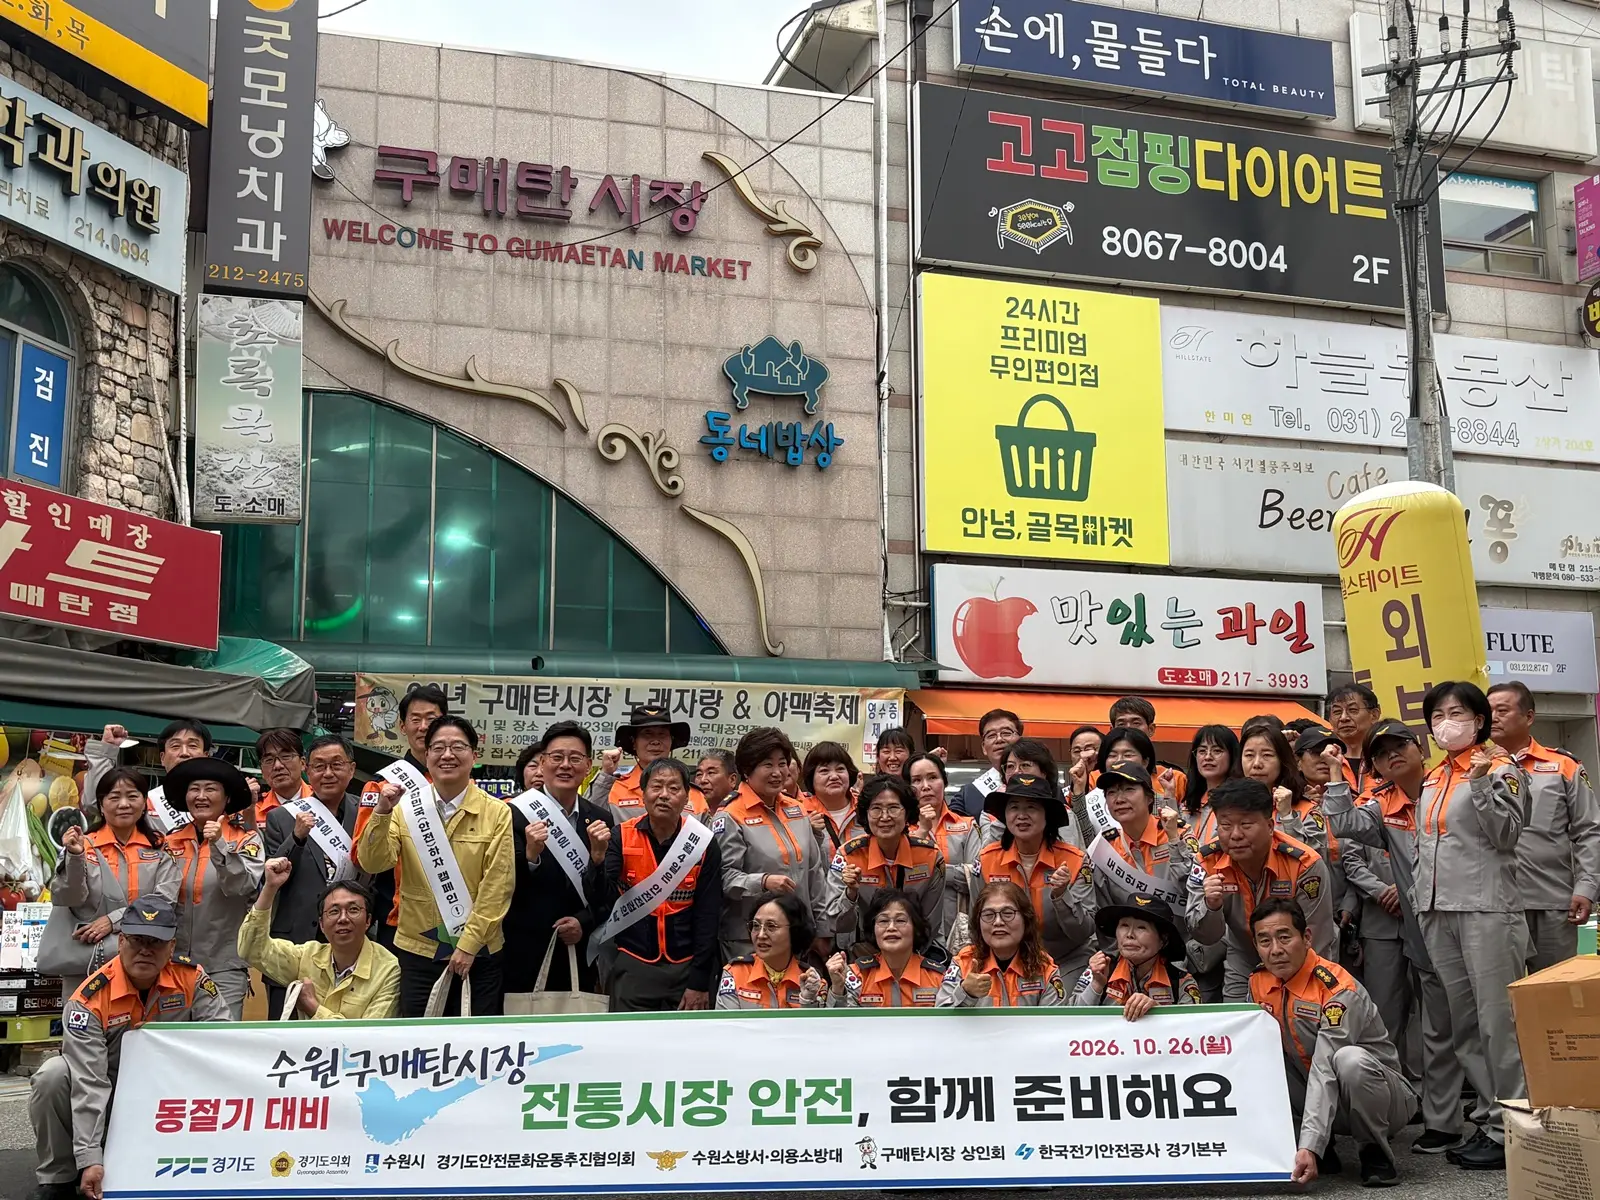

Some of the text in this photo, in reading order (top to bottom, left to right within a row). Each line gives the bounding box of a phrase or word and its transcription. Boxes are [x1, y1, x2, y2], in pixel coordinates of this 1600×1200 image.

[1222, 77, 1325, 100] TOTAL BEAUTY
[233, 15, 291, 262] 굿모닝치과
[373, 144, 708, 234] 구매탄시장
[73, 216, 150, 266] 214.0894
[322, 217, 752, 281] WELCOME TO GUMAETAN MARKET
[1101, 226, 1288, 273] 8067-8004
[208, 263, 304, 287] 212-2475
[1352, 254, 1390, 286] 2F
[1005, 296, 1080, 326] 24시간
[1000, 326, 1087, 356] 프리미엄
[990, 355, 1099, 388] 무인편의점
[1175, 354, 1212, 363] HILLSTATE
[1269, 405, 1310, 431] Tel.
[1327, 408, 1381, 438] 031)
[699, 410, 845, 469] 동네밥상
[1327, 462, 1389, 500] Cafe
[1, 488, 152, 550] 할인매장
[214, 496, 285, 515] 도·소매
[1561, 573, 1600, 582] 080-533-
[10, 582, 138, 625] 매탄점
[1049, 589, 1315, 655] 맛있는 과일
[1486, 631, 1555, 654] FLUTE
[1162, 669, 1310, 689] 도·소매 217-3993
[479, 684, 611, 718] 구매탄시장
[733, 689, 751, 720] &
[764, 690, 860, 725] 야맥축제
[867, 702, 897, 719] 영수증
[494, 719, 507, 732] 및
[513, 719, 540, 732] 장소
[1069, 1035, 1233, 1057] 2026. 10. 26.(월)
[154, 1096, 329, 1134] 동절기 대비
[521, 1073, 1237, 1132] 전통시장 안전, 함께 준비해요
[211, 1156, 256, 1173] 경기도
[298, 1154, 351, 1168] 경기도의회
[382, 1154, 425, 1169] 수원시
[436, 1150, 636, 1171] 경기도안전문화운동추진협의회
[691, 1146, 843, 1166] 수원소방서·의용소방대
[880, 1143, 1006, 1163] 구매탄시장 상인회
[1038, 1140, 1228, 1161] 한국전기안전공사 경기본부
